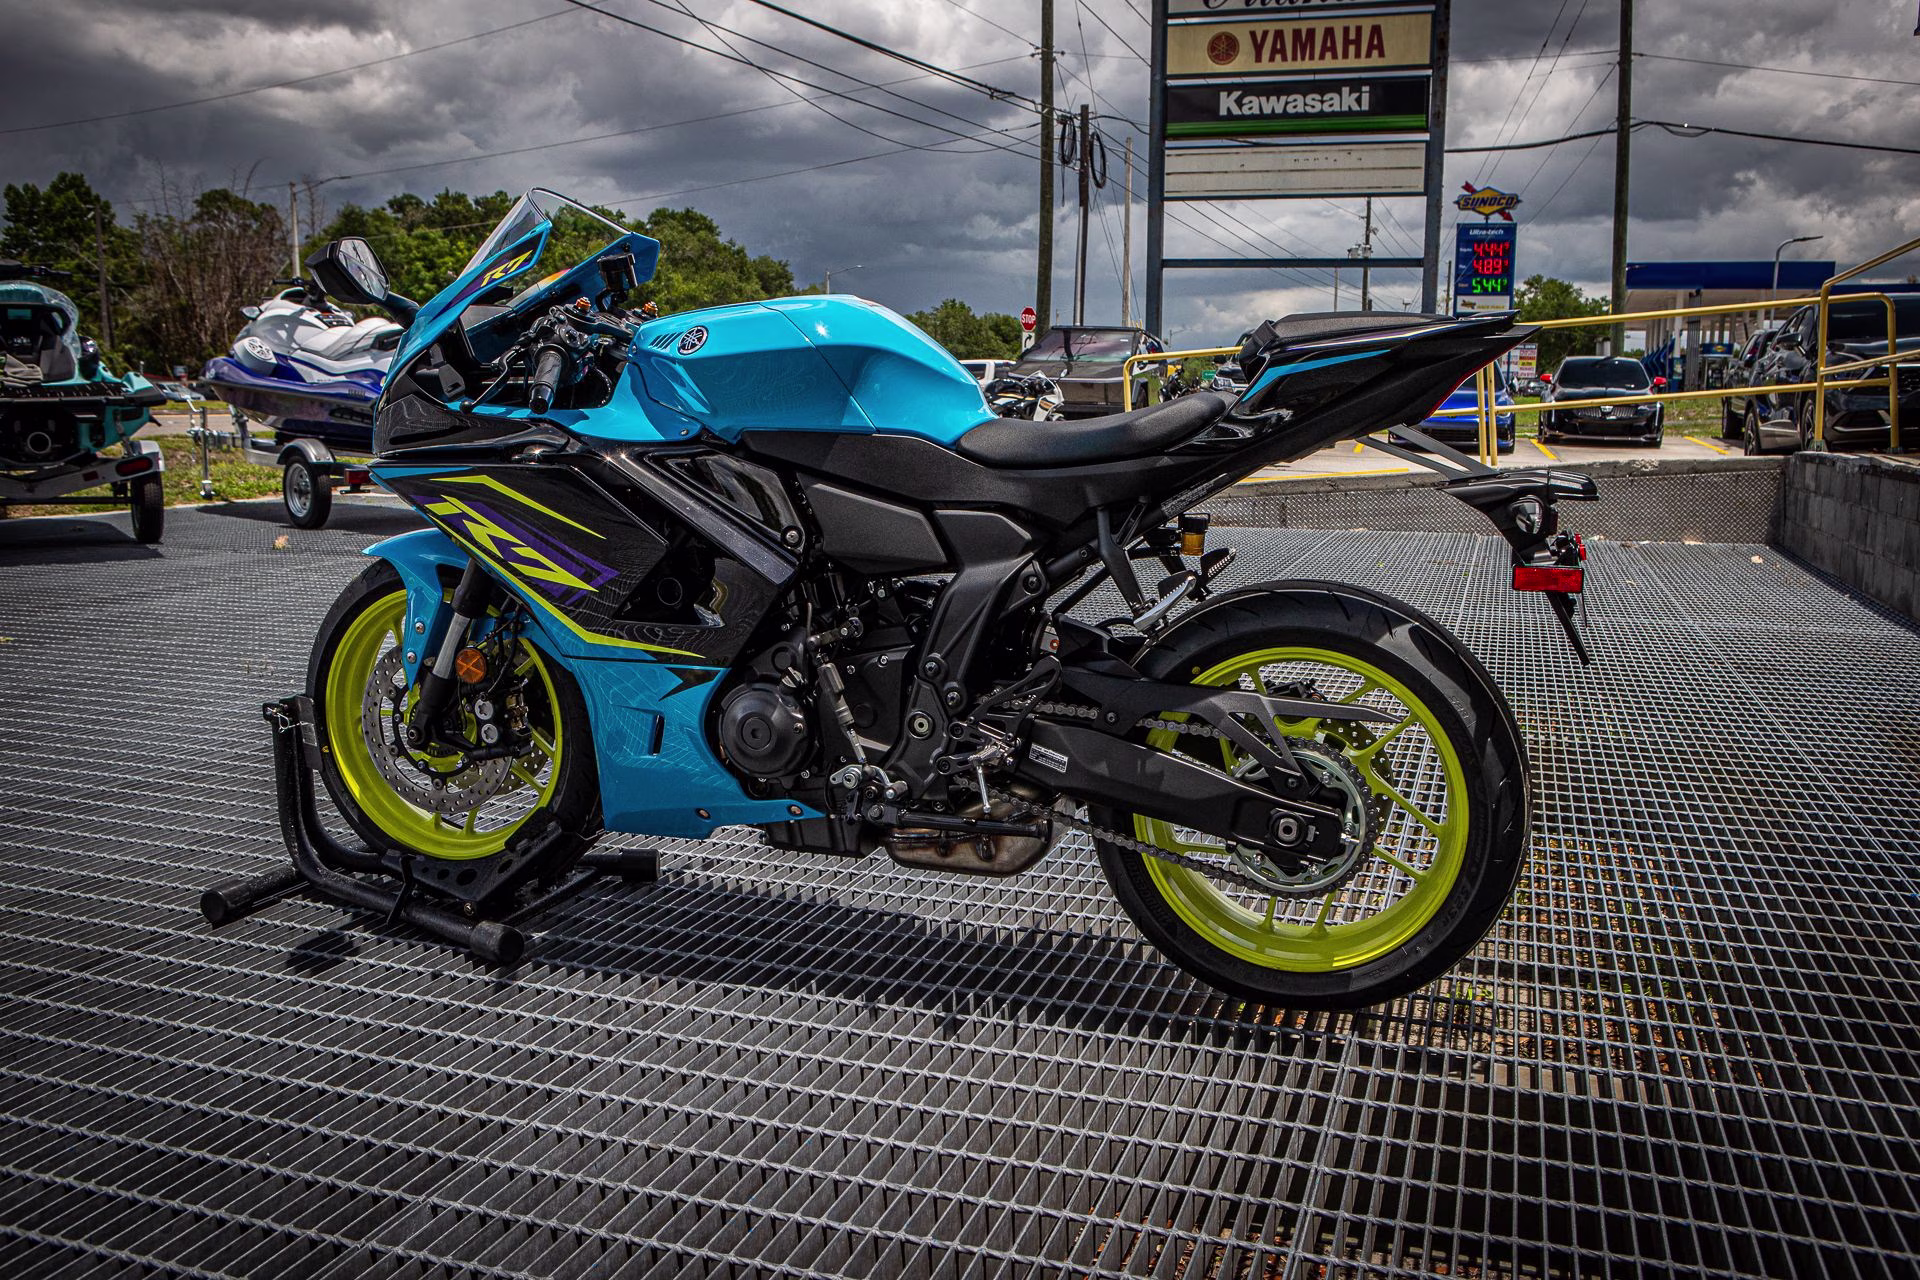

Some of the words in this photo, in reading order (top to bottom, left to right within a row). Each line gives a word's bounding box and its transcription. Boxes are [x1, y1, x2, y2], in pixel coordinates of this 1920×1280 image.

[1249, 24, 1386, 63] YAMAHA
[1219, 86, 1370, 116] Kawasaki
[1462, 195, 1515, 207] SUNOCO
[1021, 313, 1036, 324] STOP
